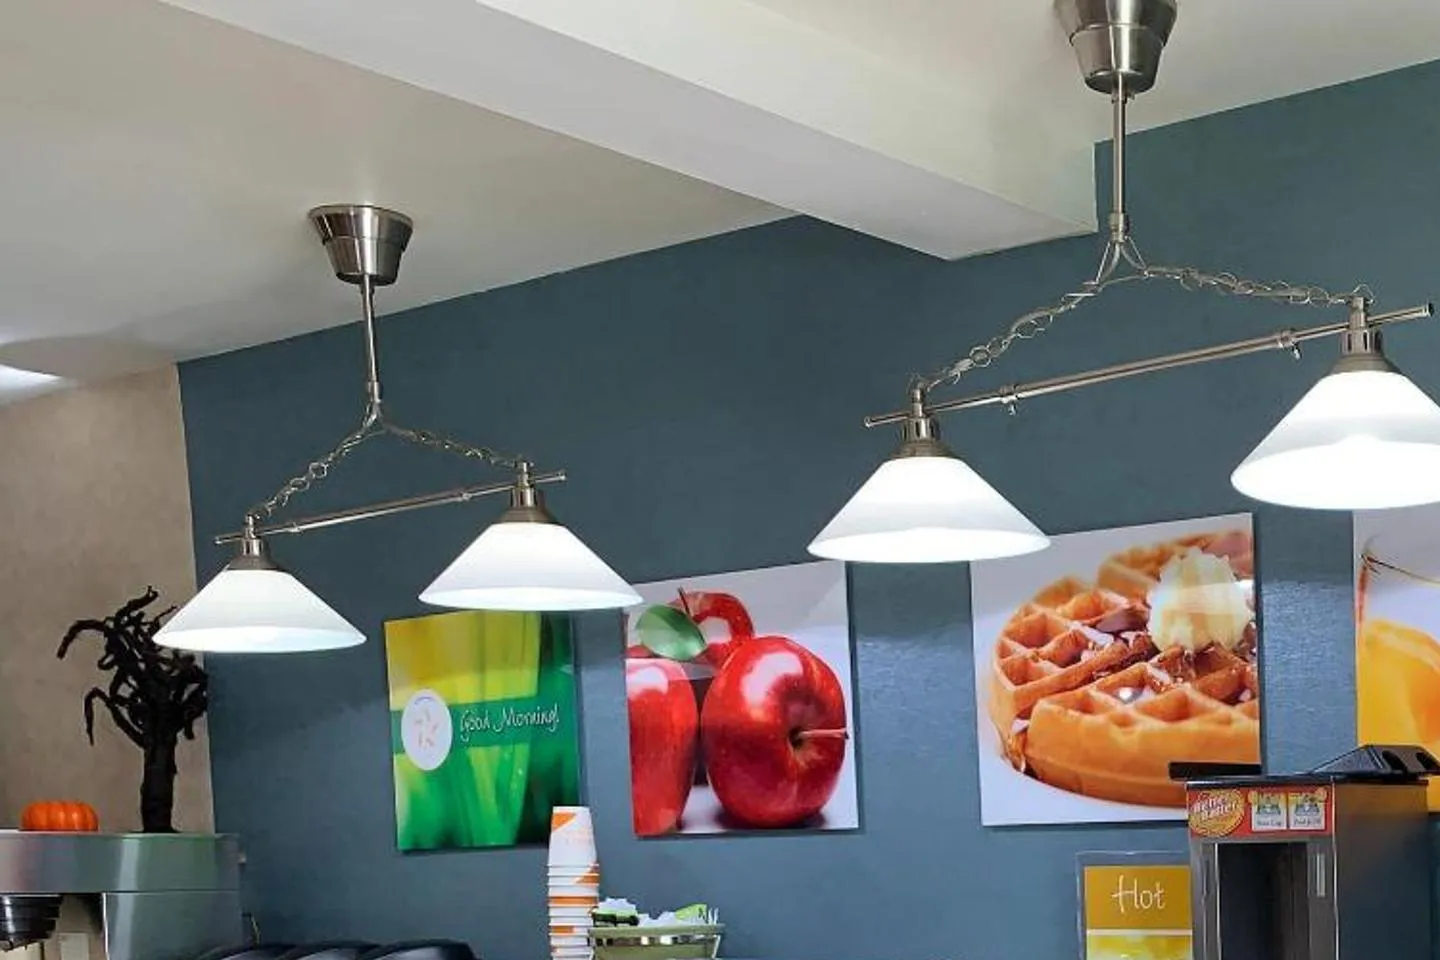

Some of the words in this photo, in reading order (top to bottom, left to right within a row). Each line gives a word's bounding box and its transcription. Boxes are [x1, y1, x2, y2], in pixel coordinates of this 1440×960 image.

[460, 710, 490, 742] Good
[492, 703, 560, 732] Morning!
[1111, 875, 1166, 914] Hot
